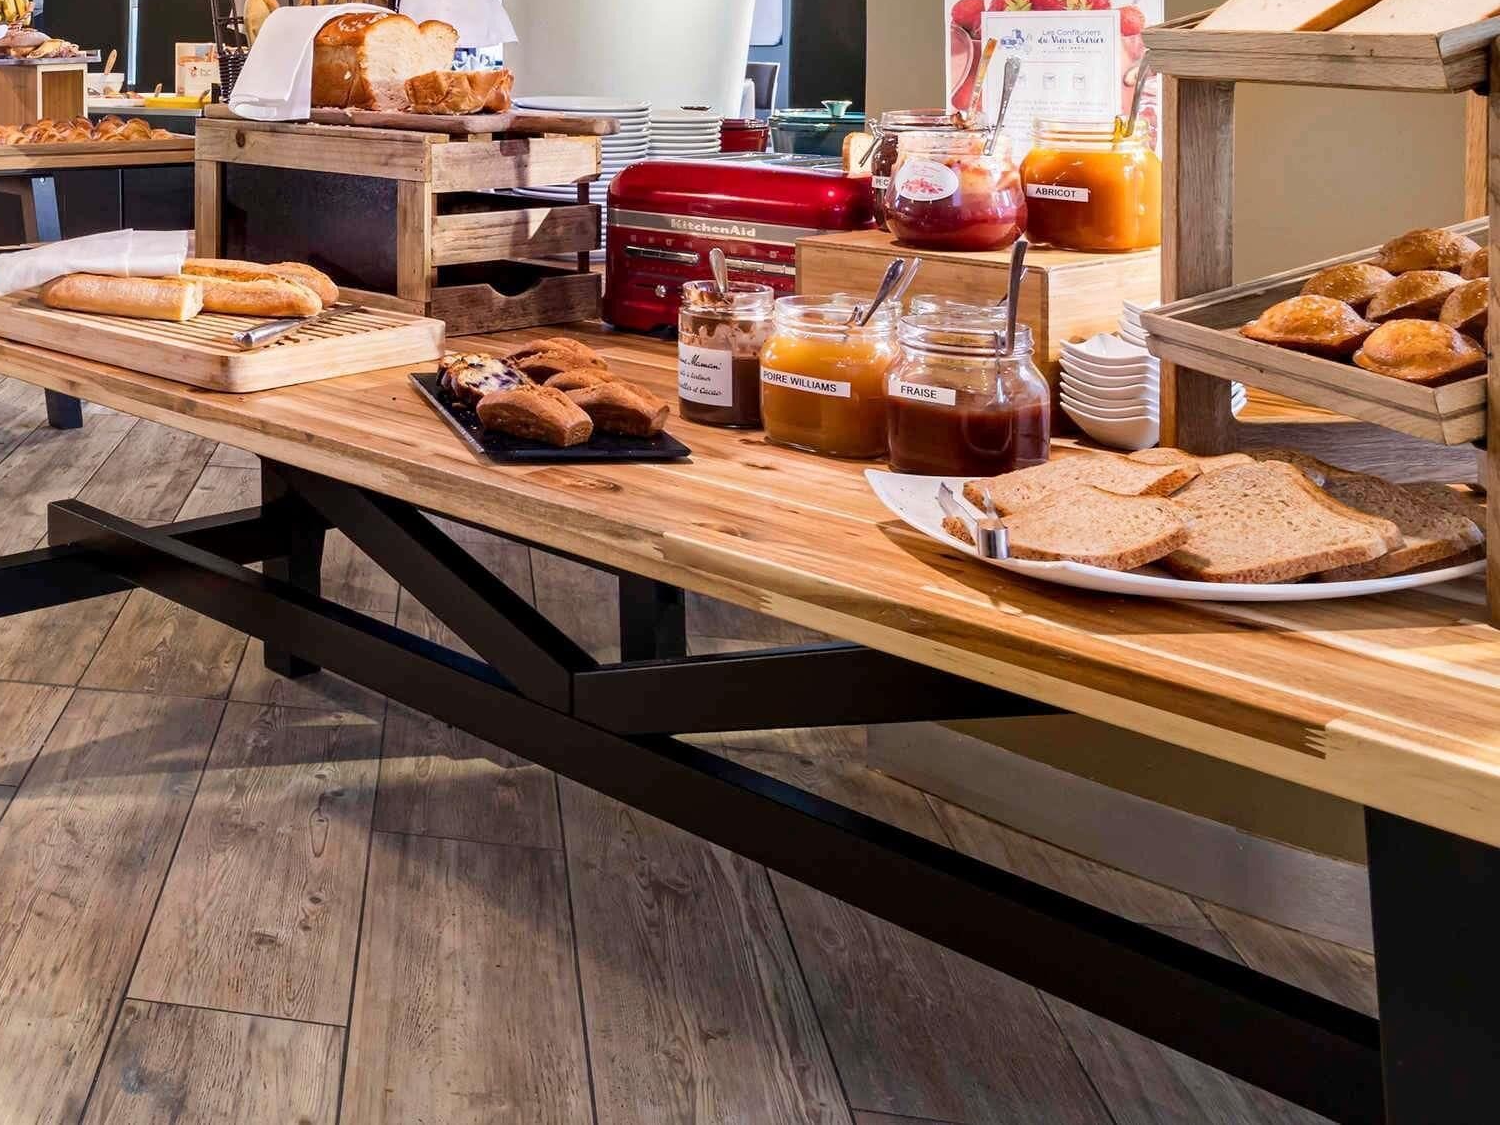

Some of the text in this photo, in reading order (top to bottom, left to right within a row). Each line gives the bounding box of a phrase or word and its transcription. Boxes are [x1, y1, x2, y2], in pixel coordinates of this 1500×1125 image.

[1035, 187, 1077, 199] ABRICOT
[670, 218, 757, 238] KitchenAid
[763, 371, 838, 394] POIRE WILLIAMS
[900, 385, 938, 400] FRAISE
